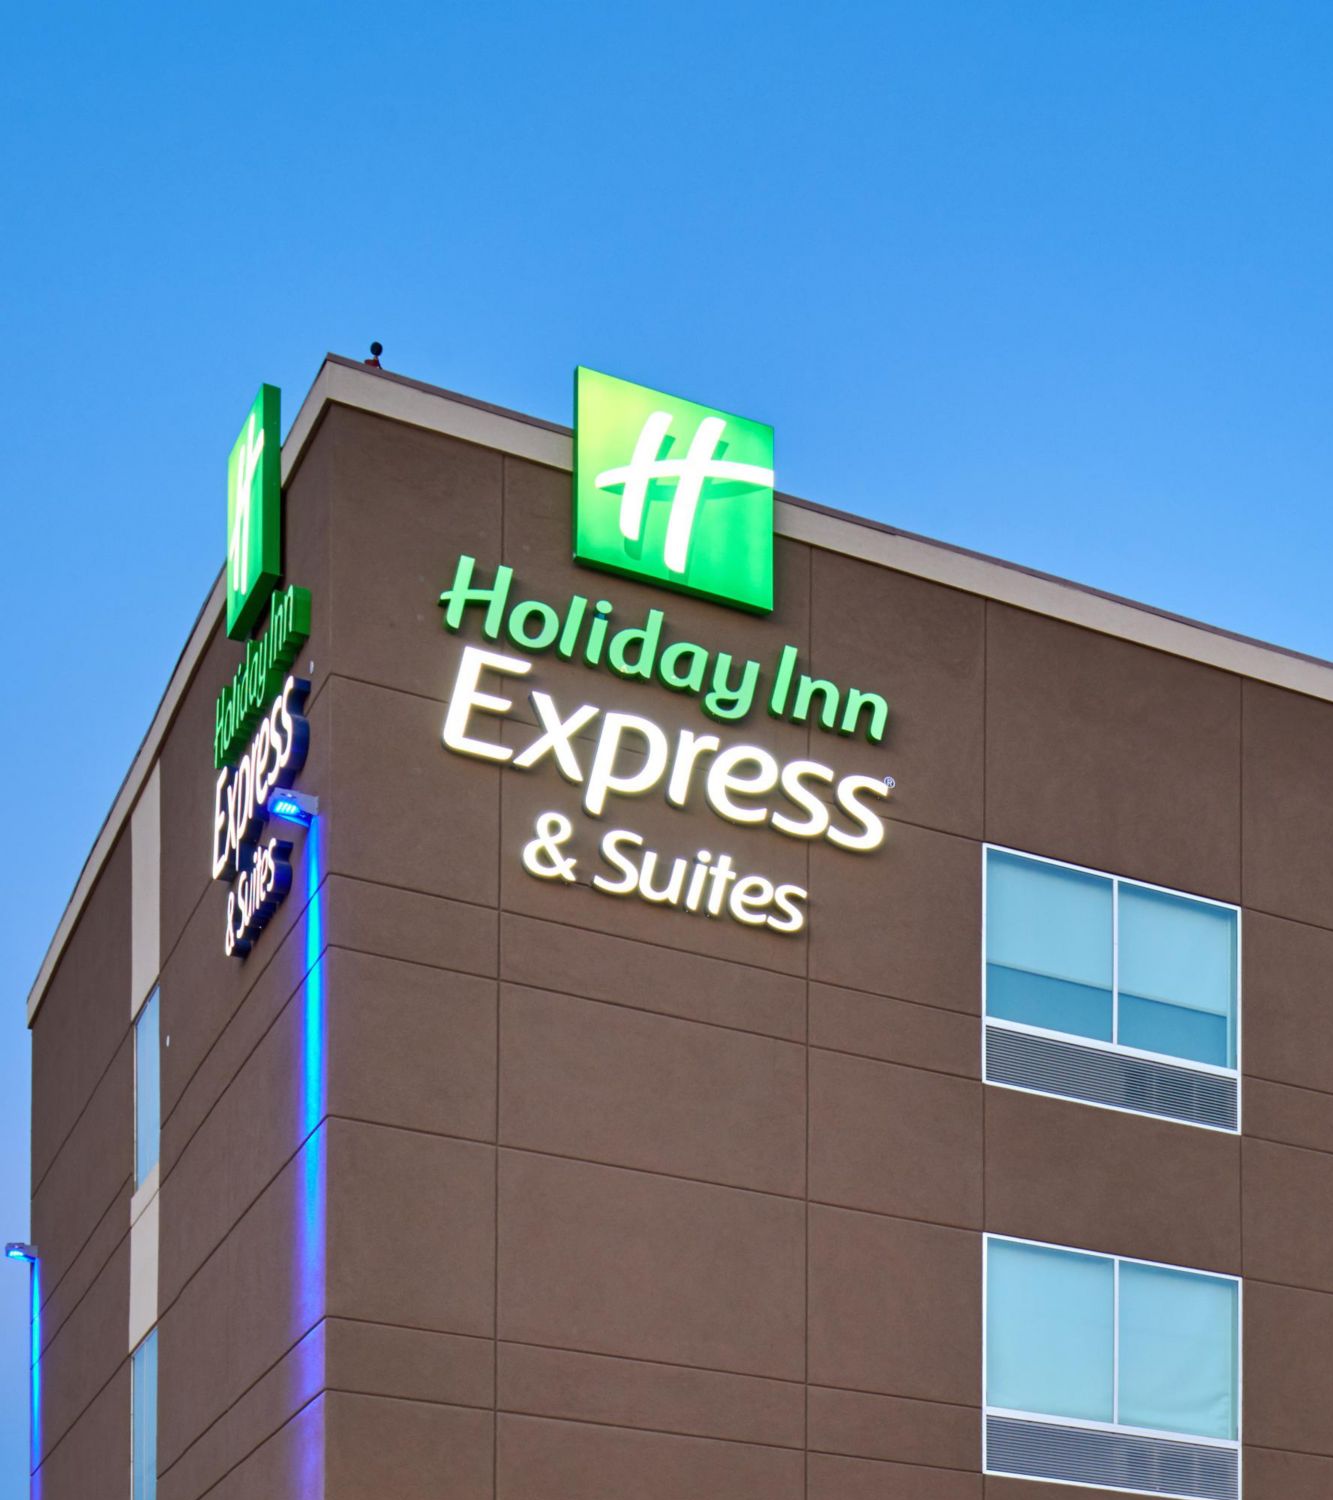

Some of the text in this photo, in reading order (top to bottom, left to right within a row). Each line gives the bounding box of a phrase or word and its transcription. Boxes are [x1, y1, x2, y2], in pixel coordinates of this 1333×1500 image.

[214, 634, 269, 768] Holiday
[439, 555, 890, 743] Holiday Inn
[213, 675, 296, 879] Express
[442, 646, 889, 852] Express
[225, 838, 276, 956] & Suites
[522, 810, 807, 935] & Suites
